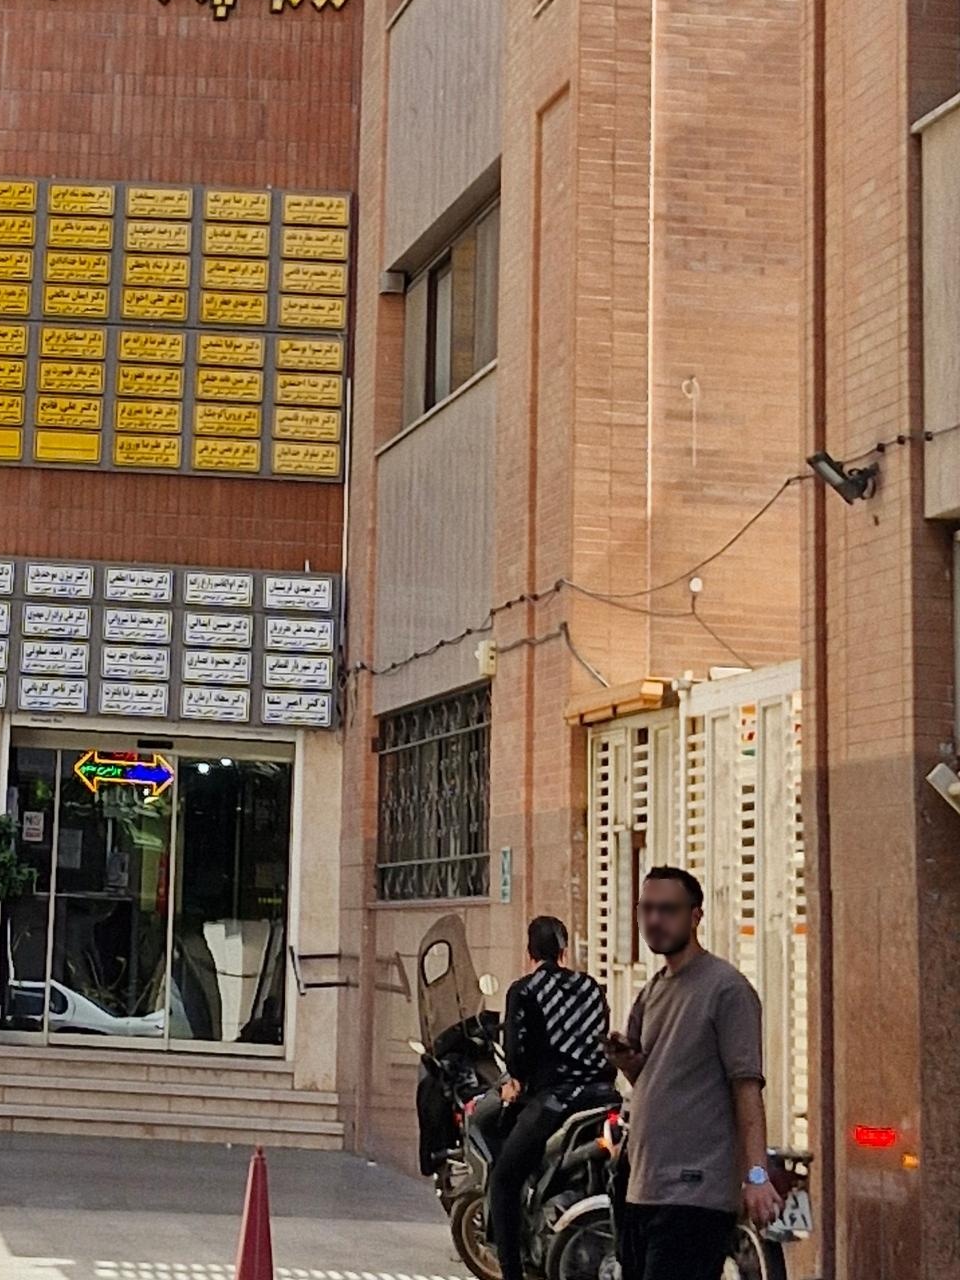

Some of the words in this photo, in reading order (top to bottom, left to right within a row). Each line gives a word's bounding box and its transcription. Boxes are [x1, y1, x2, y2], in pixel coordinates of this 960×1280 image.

[168, 294, 183, 306] دکتر
[59, 402, 75, 413] علی
[80, 402, 97, 413] دکتر
[75, 571, 89, 582] دکتر
[233, 620, 248, 632] دکتر
[70, 647, 85, 659] دکتر
[232, 656, 246, 668] دکتر
[68, 683, 82, 695] دکتر
[306, 698, 326, 710] دکتر
